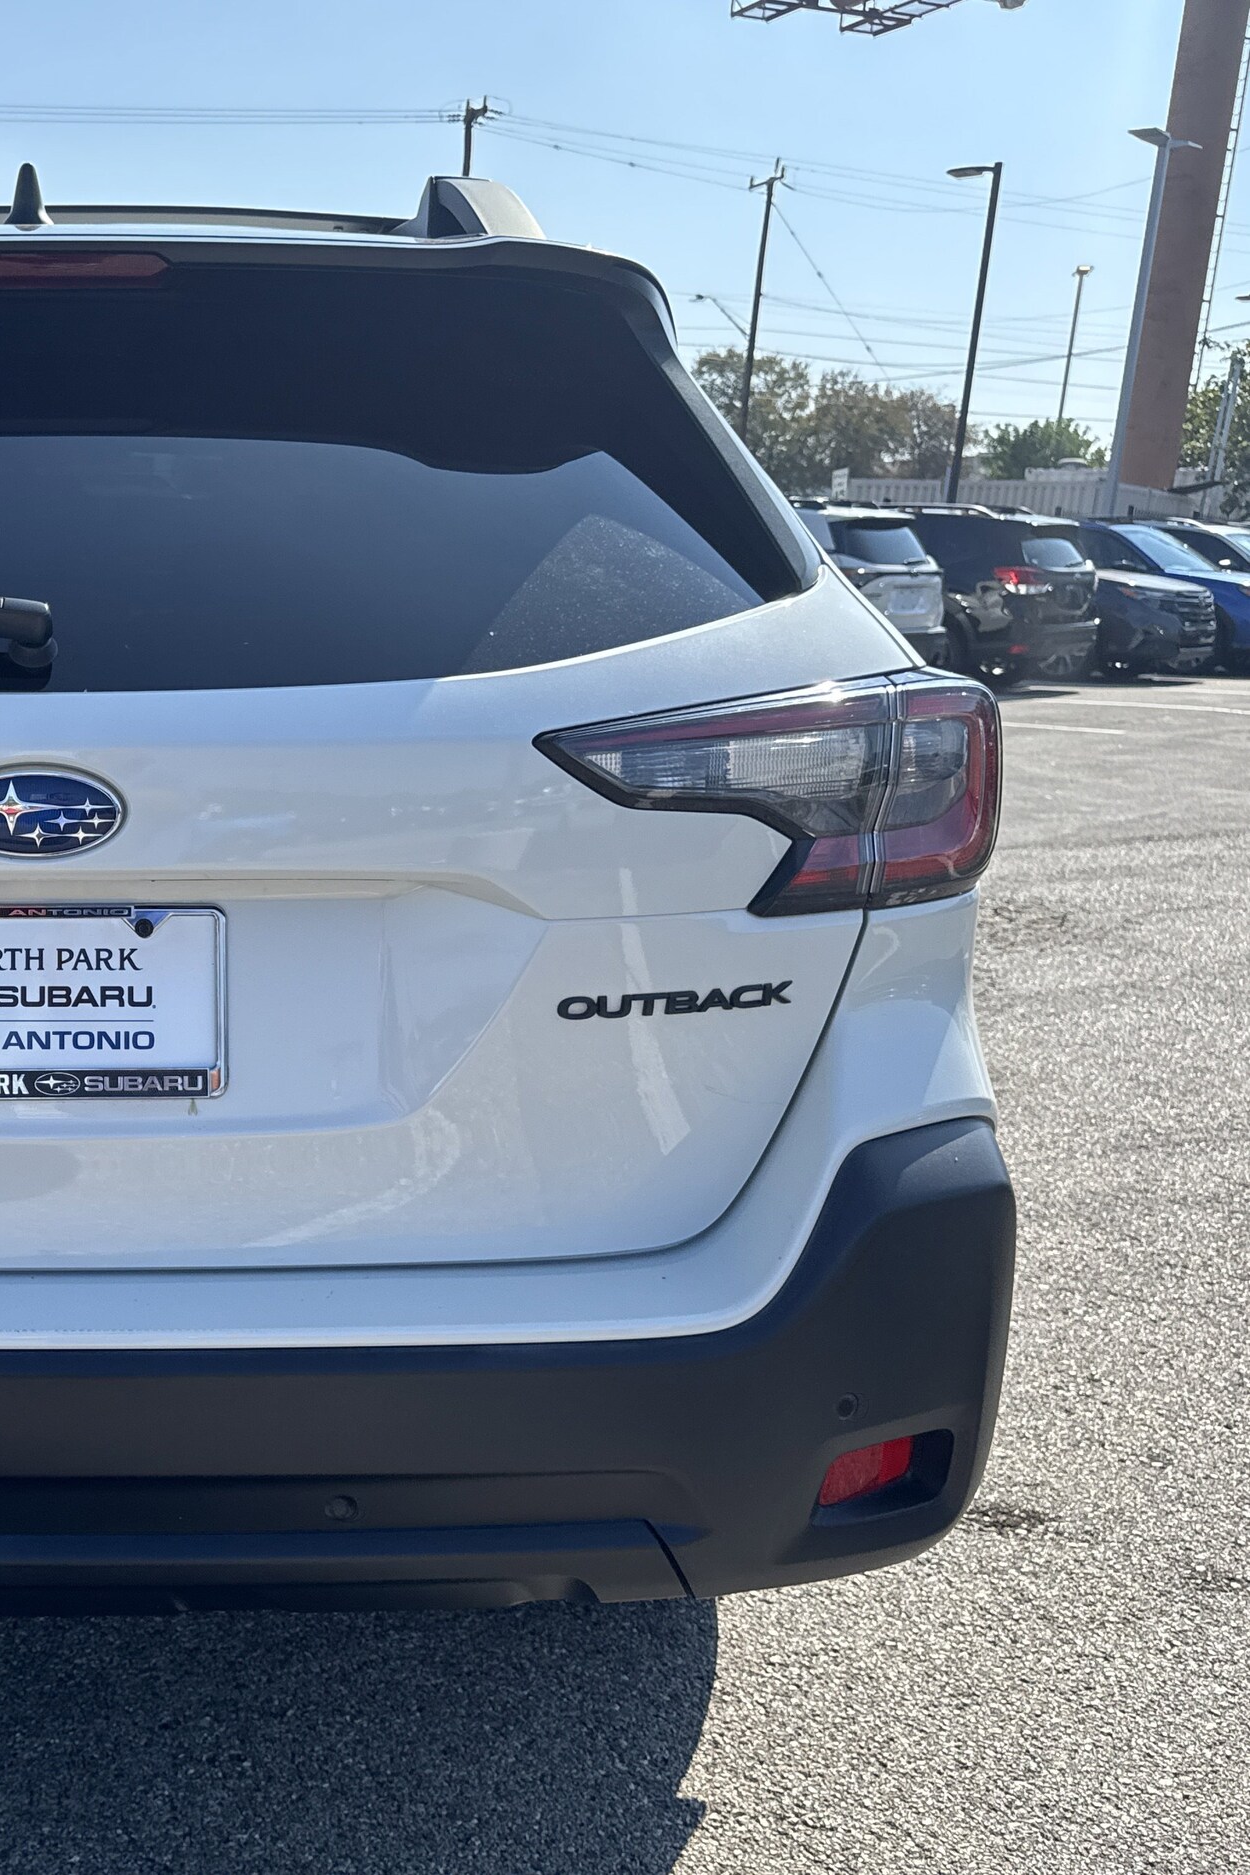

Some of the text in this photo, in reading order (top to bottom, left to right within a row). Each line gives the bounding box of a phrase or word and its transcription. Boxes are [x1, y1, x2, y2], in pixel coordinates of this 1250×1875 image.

[8, 909, 130, 917] ANTONIO
[56, 947, 143, 971] PARK
[557, 980, 793, 1020] OUTBACK
[1, 1030, 155, 1050] ANTONIO
[83, 1073, 203, 1093] SUBARU
